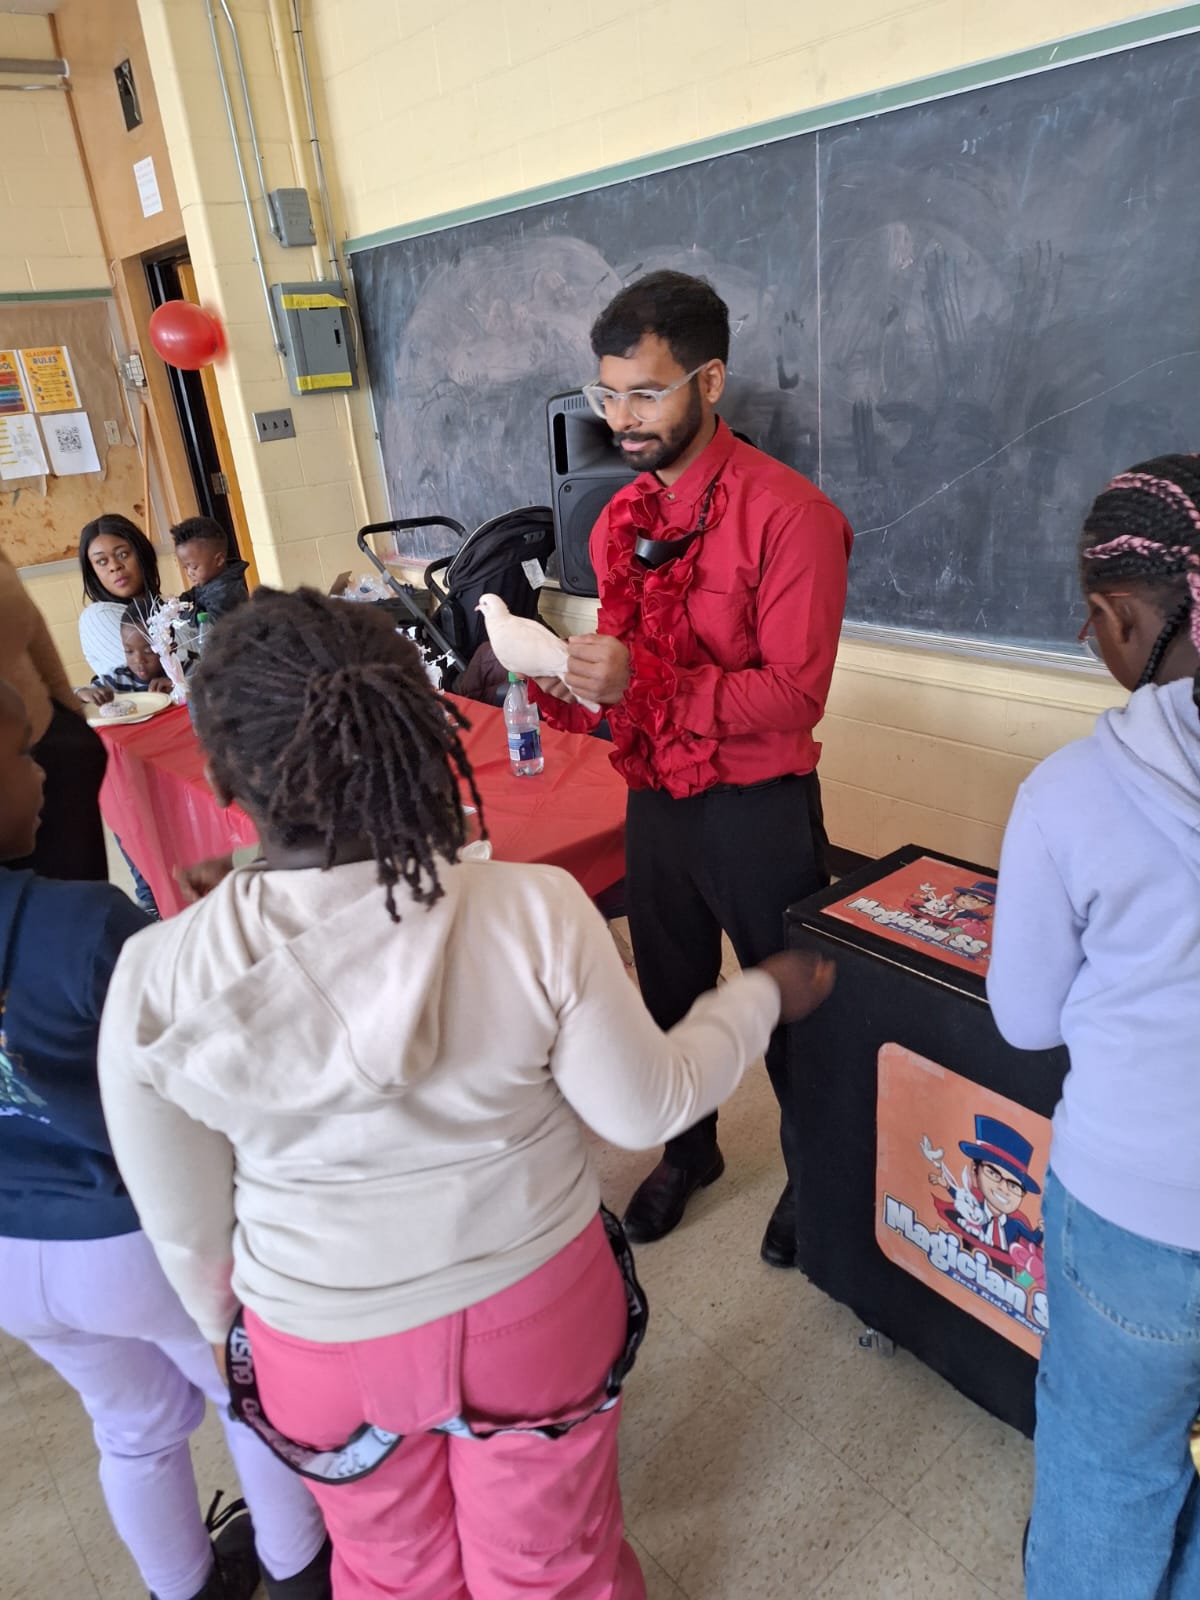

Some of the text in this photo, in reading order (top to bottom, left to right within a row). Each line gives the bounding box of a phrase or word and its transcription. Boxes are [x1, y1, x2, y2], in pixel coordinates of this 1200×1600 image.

[32, 356, 58, 364] RULES
[848, 897, 950, 941] Magician
[886, 1194, 1027, 1315] Magician
